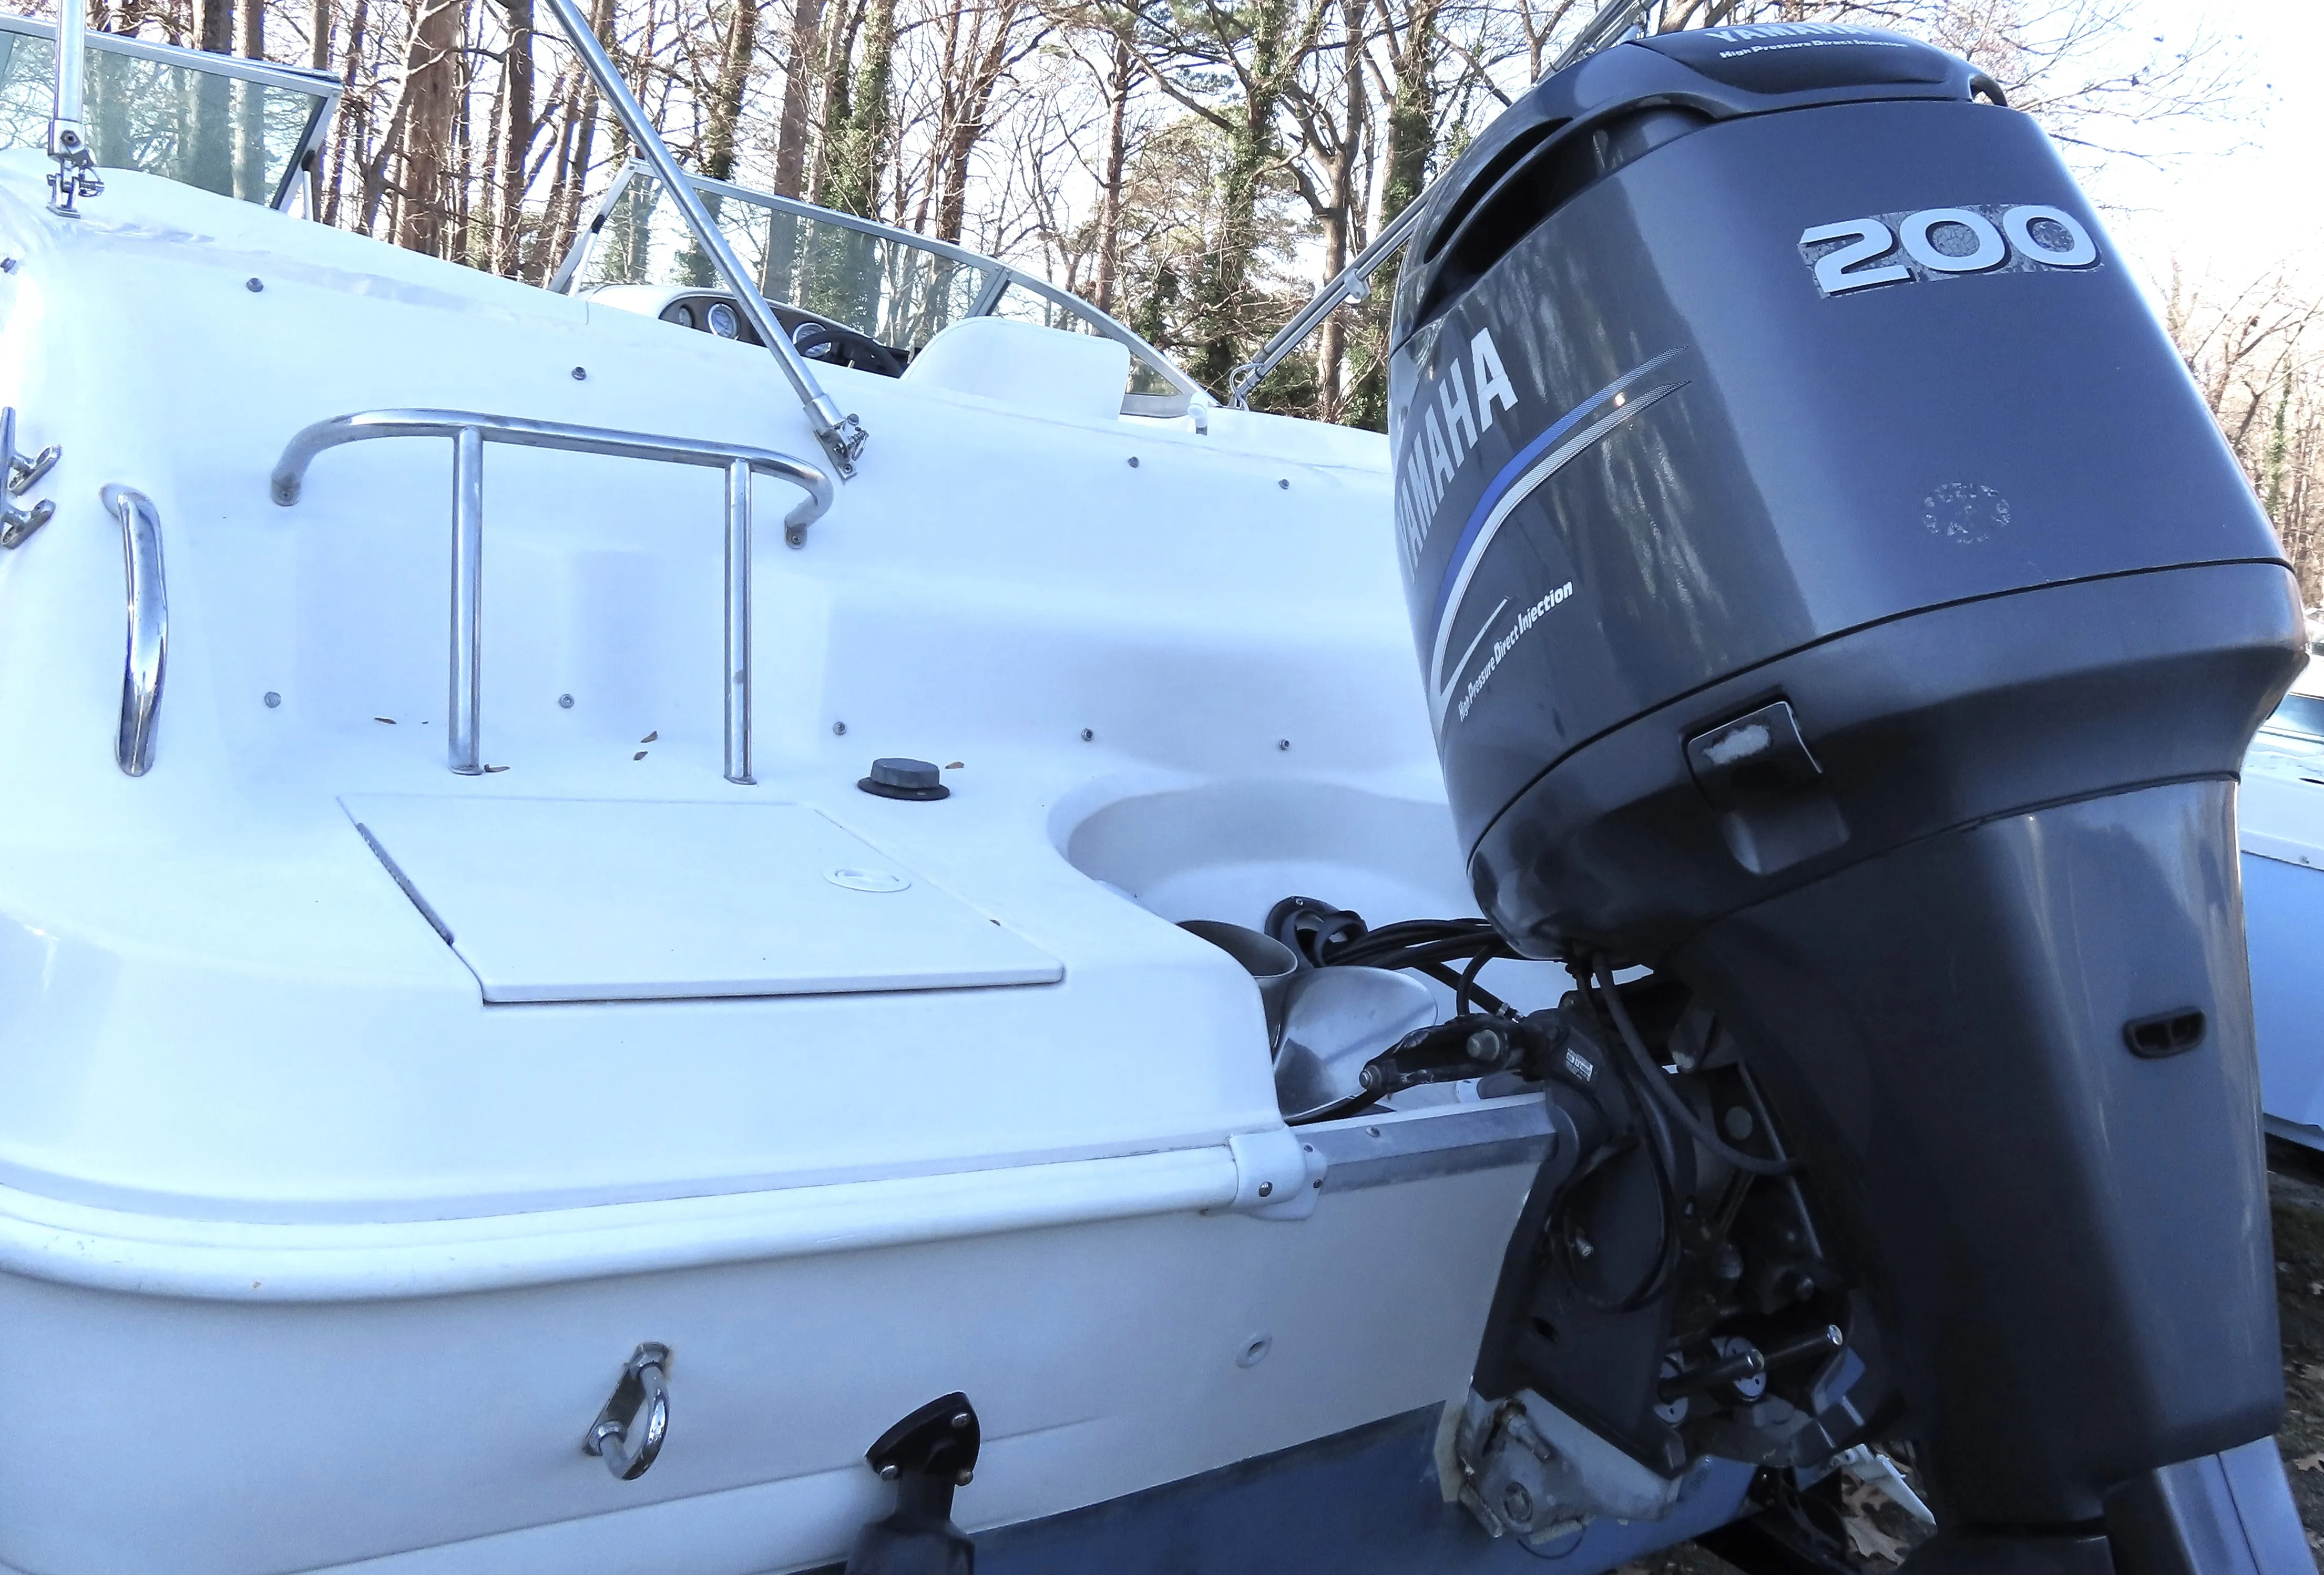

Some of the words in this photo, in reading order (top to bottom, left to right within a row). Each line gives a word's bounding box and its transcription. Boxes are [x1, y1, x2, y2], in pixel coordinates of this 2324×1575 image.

[1704, 24, 1871, 42] YAMAHA
[1718, 48, 1752, 59] High
[1750, 41, 1811, 52] Pressure
[1799, 205, 2100, 295] 200
[1458, 695, 1470, 723] High
[1468, 656, 1496, 704] Pressure
[1493, 624, 1519, 665] Direct
[1518, 581, 1573, 634] Injection
